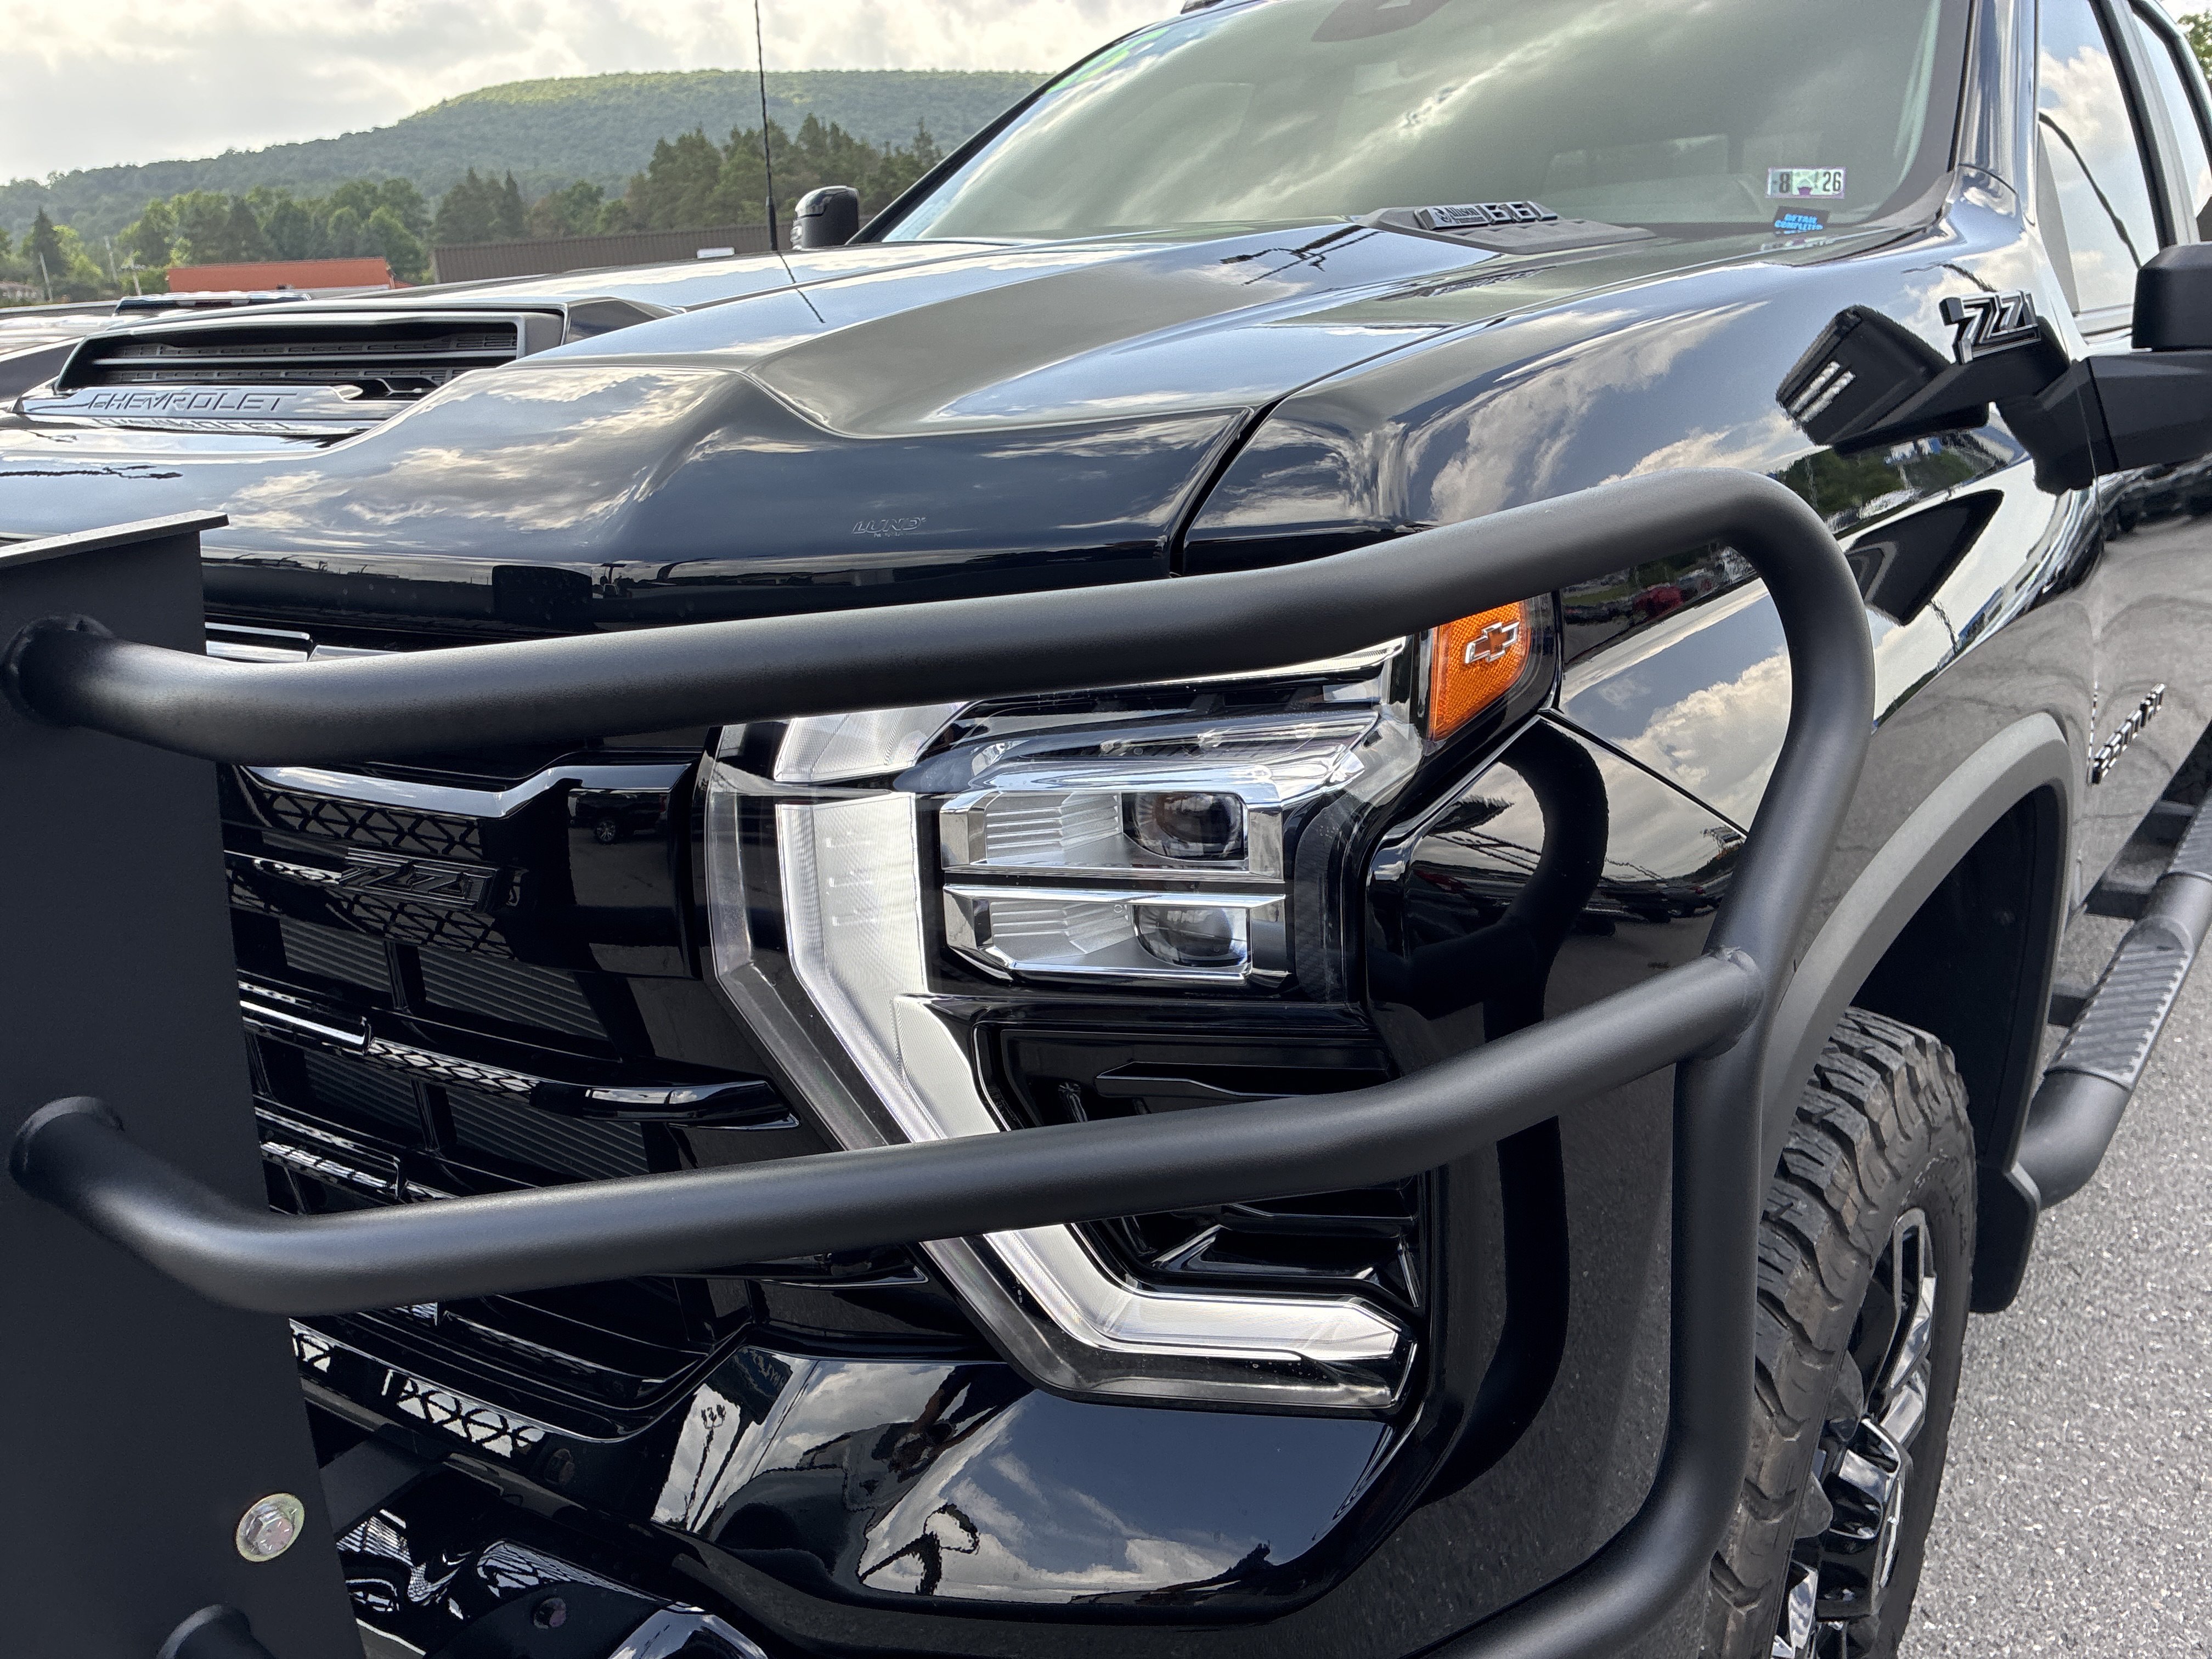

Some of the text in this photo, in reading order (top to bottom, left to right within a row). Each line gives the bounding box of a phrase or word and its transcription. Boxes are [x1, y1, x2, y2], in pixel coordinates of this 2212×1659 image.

[1779, 171, 1842, 193] 8 26
[1444, 206, 1481, 217] Allison
[88, 392, 297, 411] CHEVROLET
